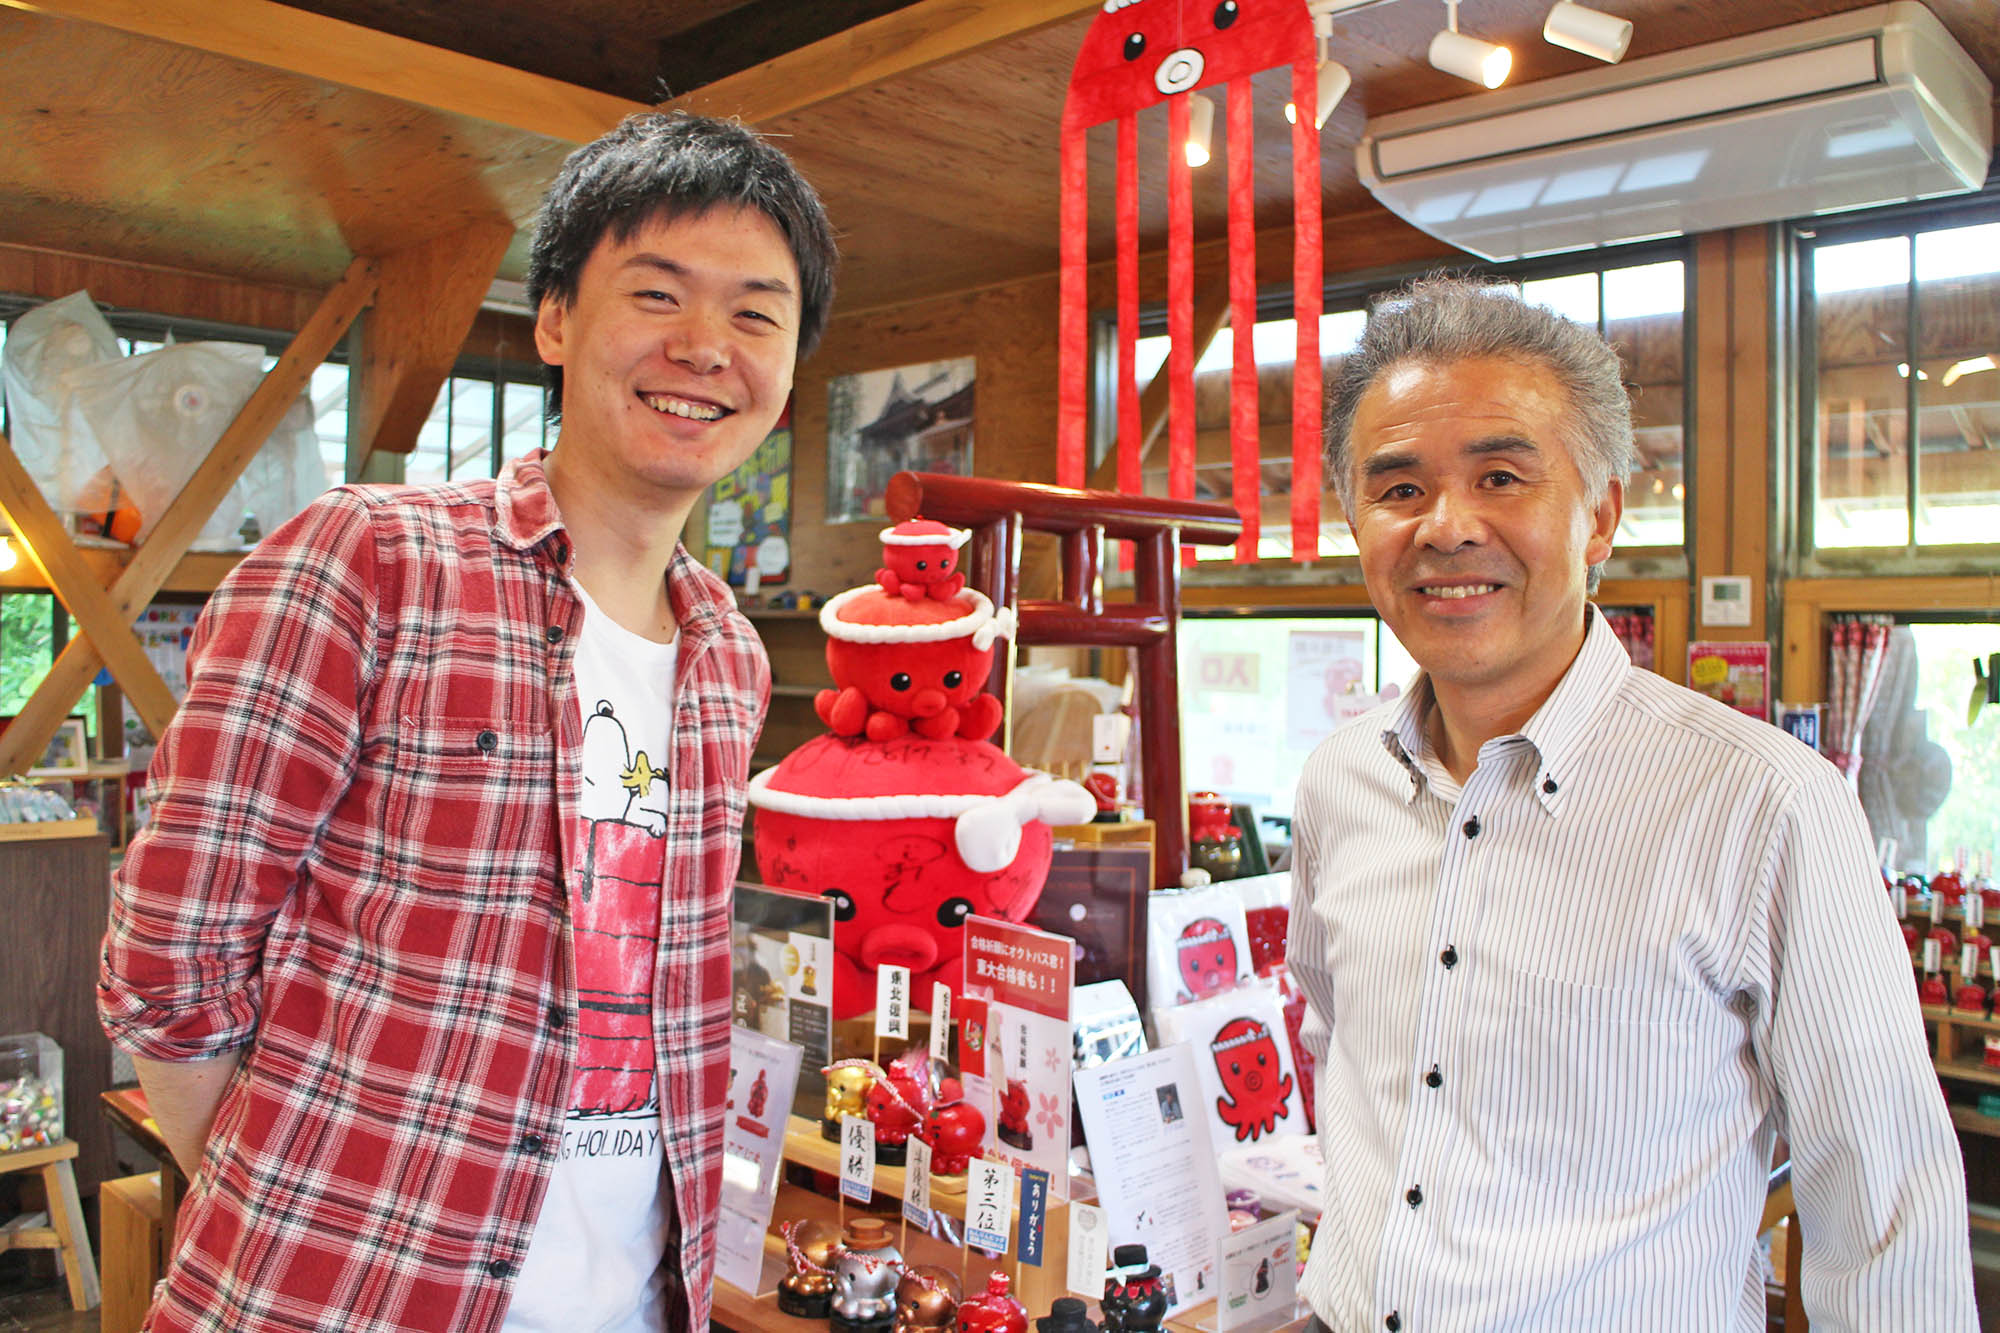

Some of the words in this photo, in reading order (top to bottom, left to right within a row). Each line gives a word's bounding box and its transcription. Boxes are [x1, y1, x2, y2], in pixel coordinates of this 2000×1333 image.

[575, 1129, 660, 1158] HOLIDAY
[977, 1168, 999, 1231] 第三位
[1027, 1183, 1041, 1257] ありがとう
